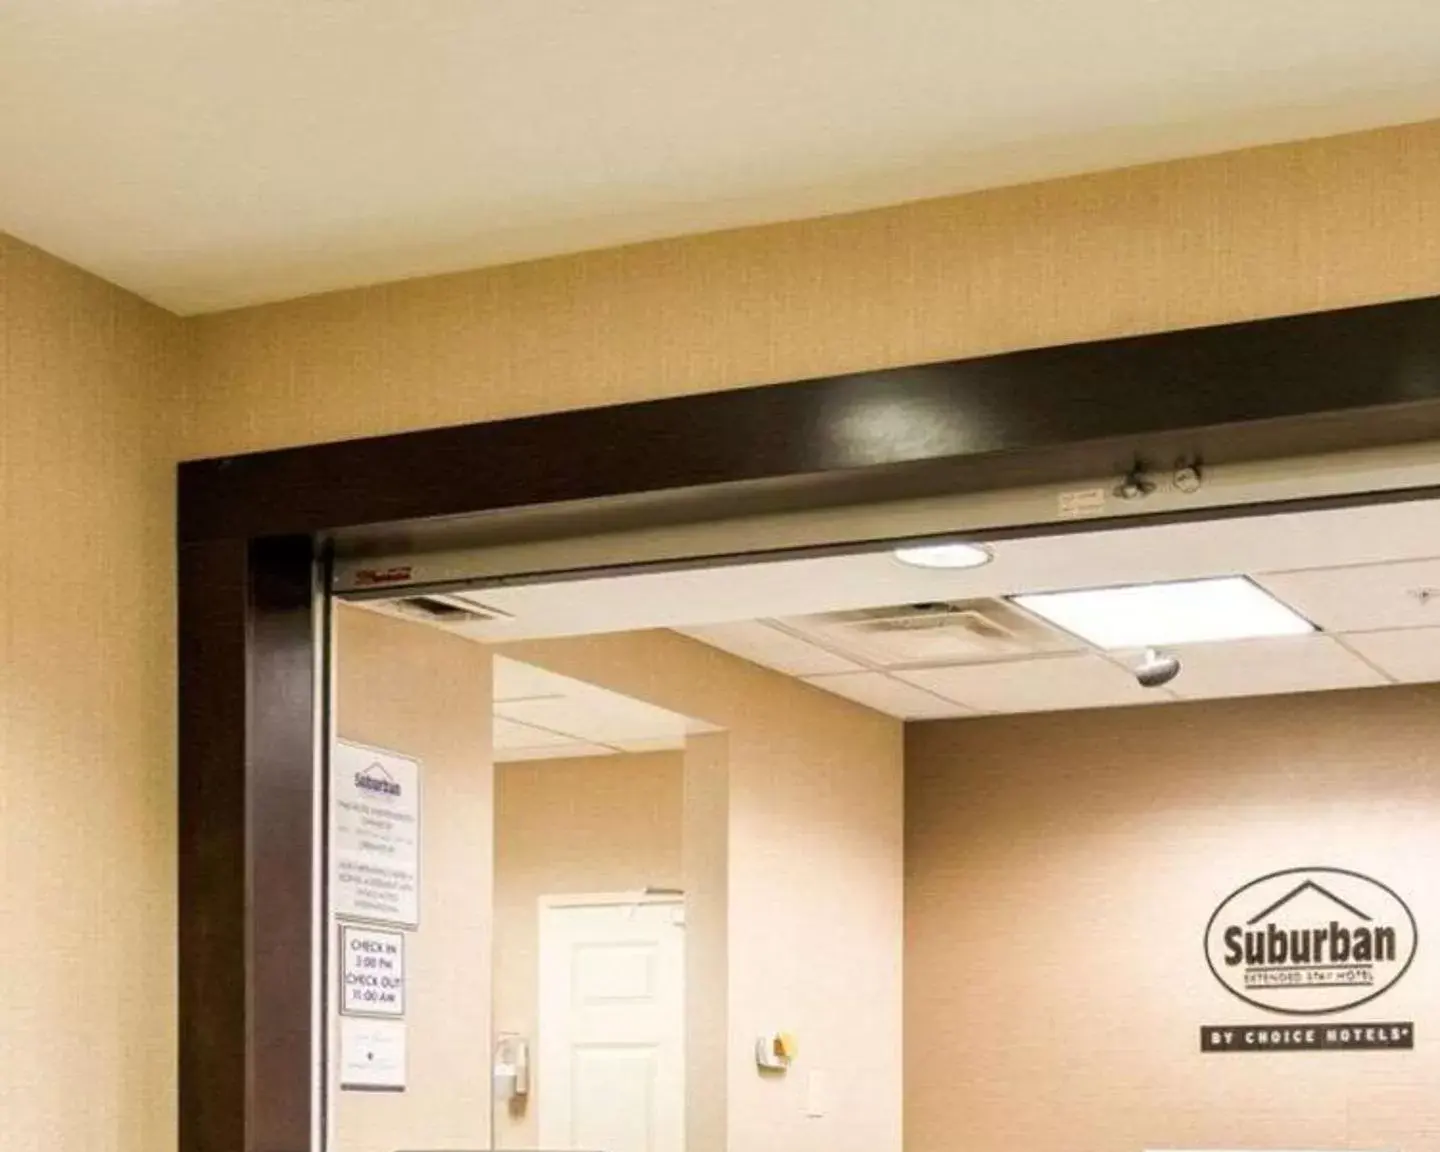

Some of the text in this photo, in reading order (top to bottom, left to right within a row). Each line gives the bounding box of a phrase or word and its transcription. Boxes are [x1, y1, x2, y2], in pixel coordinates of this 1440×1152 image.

[351, 939, 396, 954] CHECK IN
[1224, 921, 1396, 966] Suburban
[379, 957, 393, 969] PM
[346, 973, 400, 989] CHECK OUT
[1244, 971, 1302, 984] EXTENDED
[1336, 969, 1373, 981] HOTEL
[380, 991, 396, 1003] AM
[1210, 1032, 1234, 1045] BY
[1245, 1029, 1316, 1044] CHOICE
